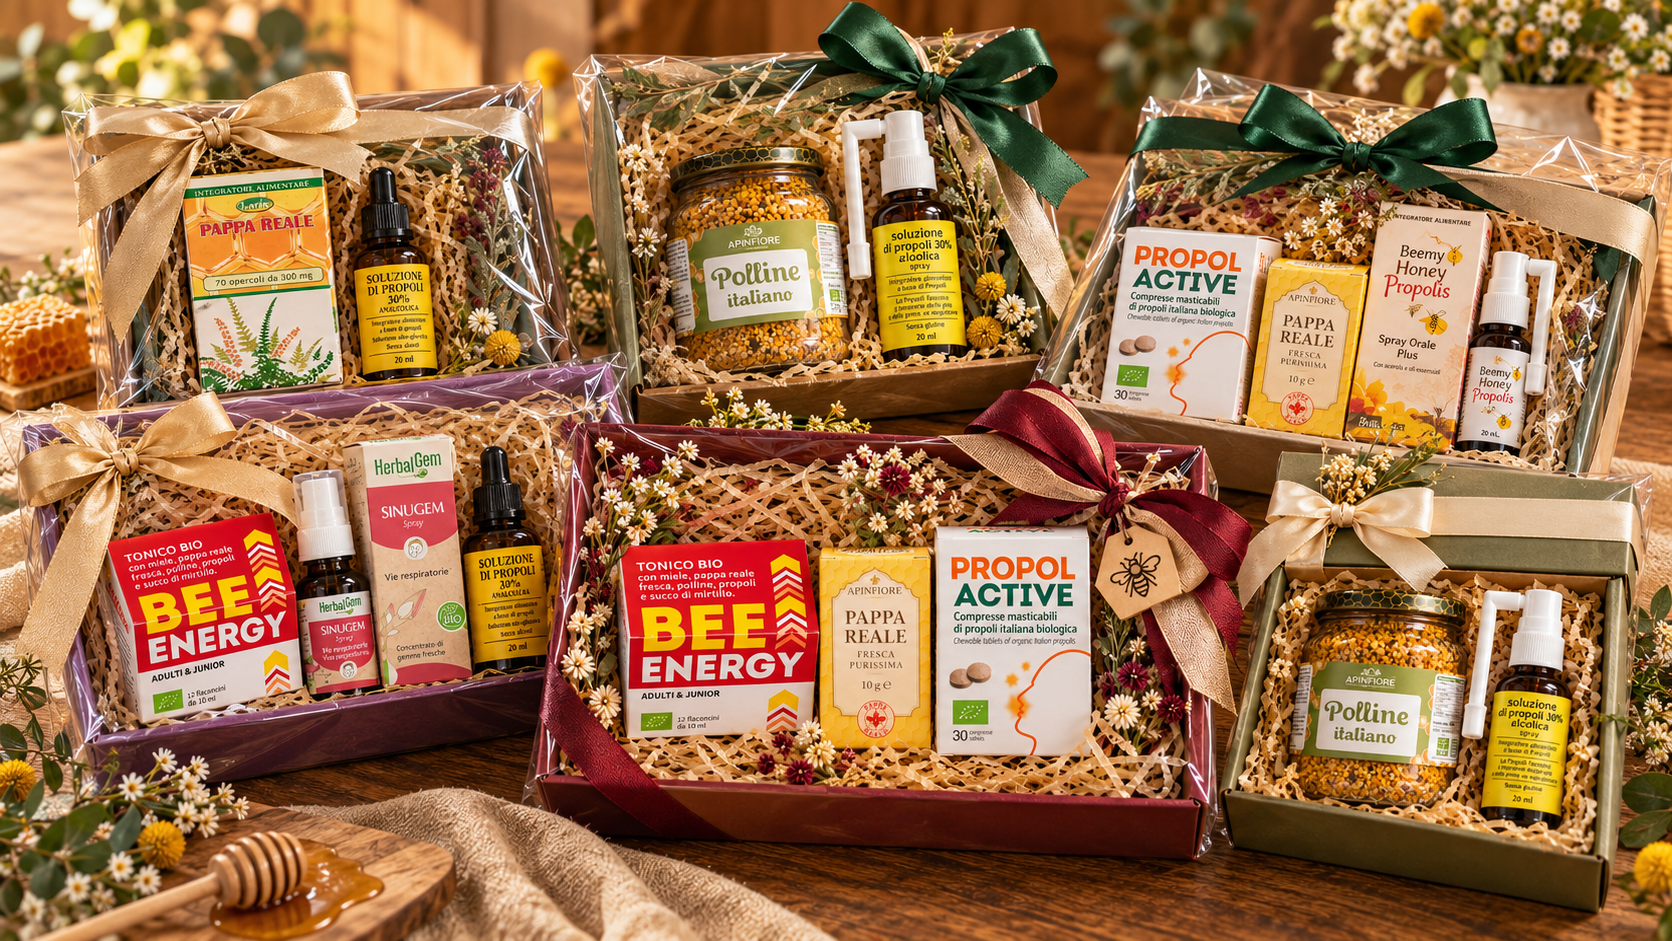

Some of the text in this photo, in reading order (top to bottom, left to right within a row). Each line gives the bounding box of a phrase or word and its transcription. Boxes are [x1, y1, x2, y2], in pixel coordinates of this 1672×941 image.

[200, 215, 315, 237] PAPPA REALE
[891, 227, 943, 242] soluzione
[727, 235, 781, 250] APINFIORE
[883, 240, 952, 255] di propoli 30%
[1134, 245, 1242, 273] PROPOL
[1400, 244, 1445, 265] Beemy
[366, 271, 423, 285] SOLUZIONE
[711, 261, 801, 290] Polline
[1396, 260, 1447, 283] Honey
[215, 279, 226, 287] 70
[229, 275, 265, 287] opercoli
[267, 274, 278, 282] da
[281, 272, 297, 281] 300
[1132, 268, 1238, 295] ACTIVE
[367, 282, 424, 296] DI PROPOLI
[1384, 274, 1451, 302] Propolis
[727, 289, 793, 308] italiano
[1130, 291, 1221, 306] Compresse masticabili
[1128, 302, 1137, 311] di
[1138, 303, 1167, 314] propoli
[1200, 307, 1236, 319] biologica
[1282, 314, 1335, 332] PAPPA
[916, 333, 925, 341] 20
[1280, 330, 1334, 348] REALE
[1378, 334, 1436, 350] Spray Orale
[394, 356, 403, 364] 20
[1396, 348, 1418, 360] Plus
[1288, 375, 1299, 383] 10
[1480, 366, 1511, 380] Beemy
[1479, 377, 1512, 392] Honey
[1113, 388, 1128, 400] 30
[1472, 387, 1514, 405] Propolis
[374, 452, 442, 476] HerbalGem
[381, 501, 445, 519] SINUGEM
[124, 540, 203, 563] TONICO BIO
[128, 563, 146, 572] con
[478, 553, 535, 569] SOLUZIONE
[636, 559, 723, 571] TONICO BIO
[951, 556, 1076, 580] PROPOL
[384, 567, 449, 581] Vie respiratorie
[480, 565, 536, 581] DI PROPOLI
[638, 574, 657, 582] con
[729, 569, 755, 578] reale
[719, 578, 756, 589] propoli
[847, 586, 902, 596] APINFIORE
[681, 590, 691, 599] di
[953, 583, 1074, 607] ACTIVE
[138, 574, 253, 635] BEE
[845, 610, 906, 625] PAPPA
[953, 611, 1058, 623] Compresse masticabili
[320, 621, 366, 636] SINUGEM
[641, 603, 766, 652] BEE
[953, 623, 1078, 636] di propoli italiana biologica
[148, 610, 287, 665] ENERGY
[845, 629, 907, 644] REALE
[508, 644, 517, 652] 20
[857, 650, 895, 659] FRESCA
[151, 660, 225, 683] ADULTI & JUNIOR
[641, 651, 805, 683] ENERGY
[849, 661, 903, 669] PURISSIMA
[862, 681, 880, 692] 10 g
[1345, 675, 1396, 687] APINFIORE
[641, 689, 720, 700] ADULTI & JUNIOR
[1507, 697, 1557, 712] soluzione
[1324, 700, 1409, 726] Polline
[1498, 708, 1507, 717] di
[952, 729, 968, 742] 30
[1334, 726, 1397, 745] italiano
[1512, 794, 1521, 802] 20
